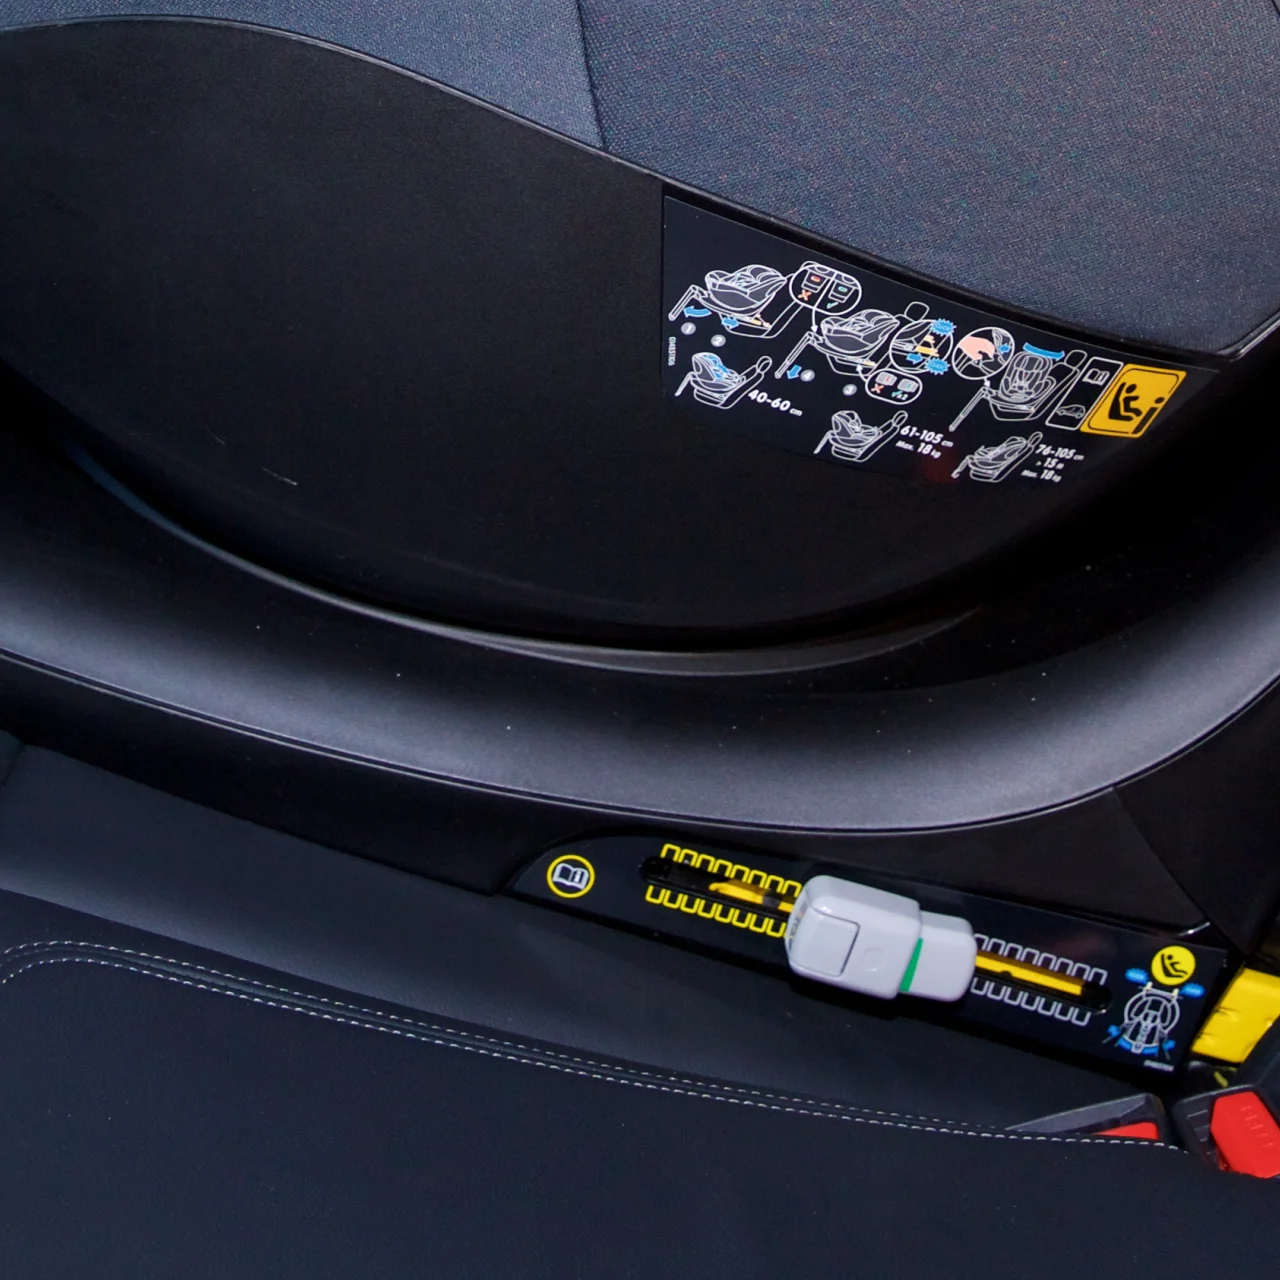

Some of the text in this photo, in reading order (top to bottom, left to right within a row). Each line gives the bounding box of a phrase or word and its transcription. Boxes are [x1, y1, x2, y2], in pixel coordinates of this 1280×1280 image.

[748, 389, 791, 411] 40-60
[900, 424, 944, 444] 61-105
[917, 442, 933, 455] 18
[1035, 443, 1076, 460] 76-105
[1043, 457, 1059, 468] 15
[1040, 469, 1055, 480] 18
